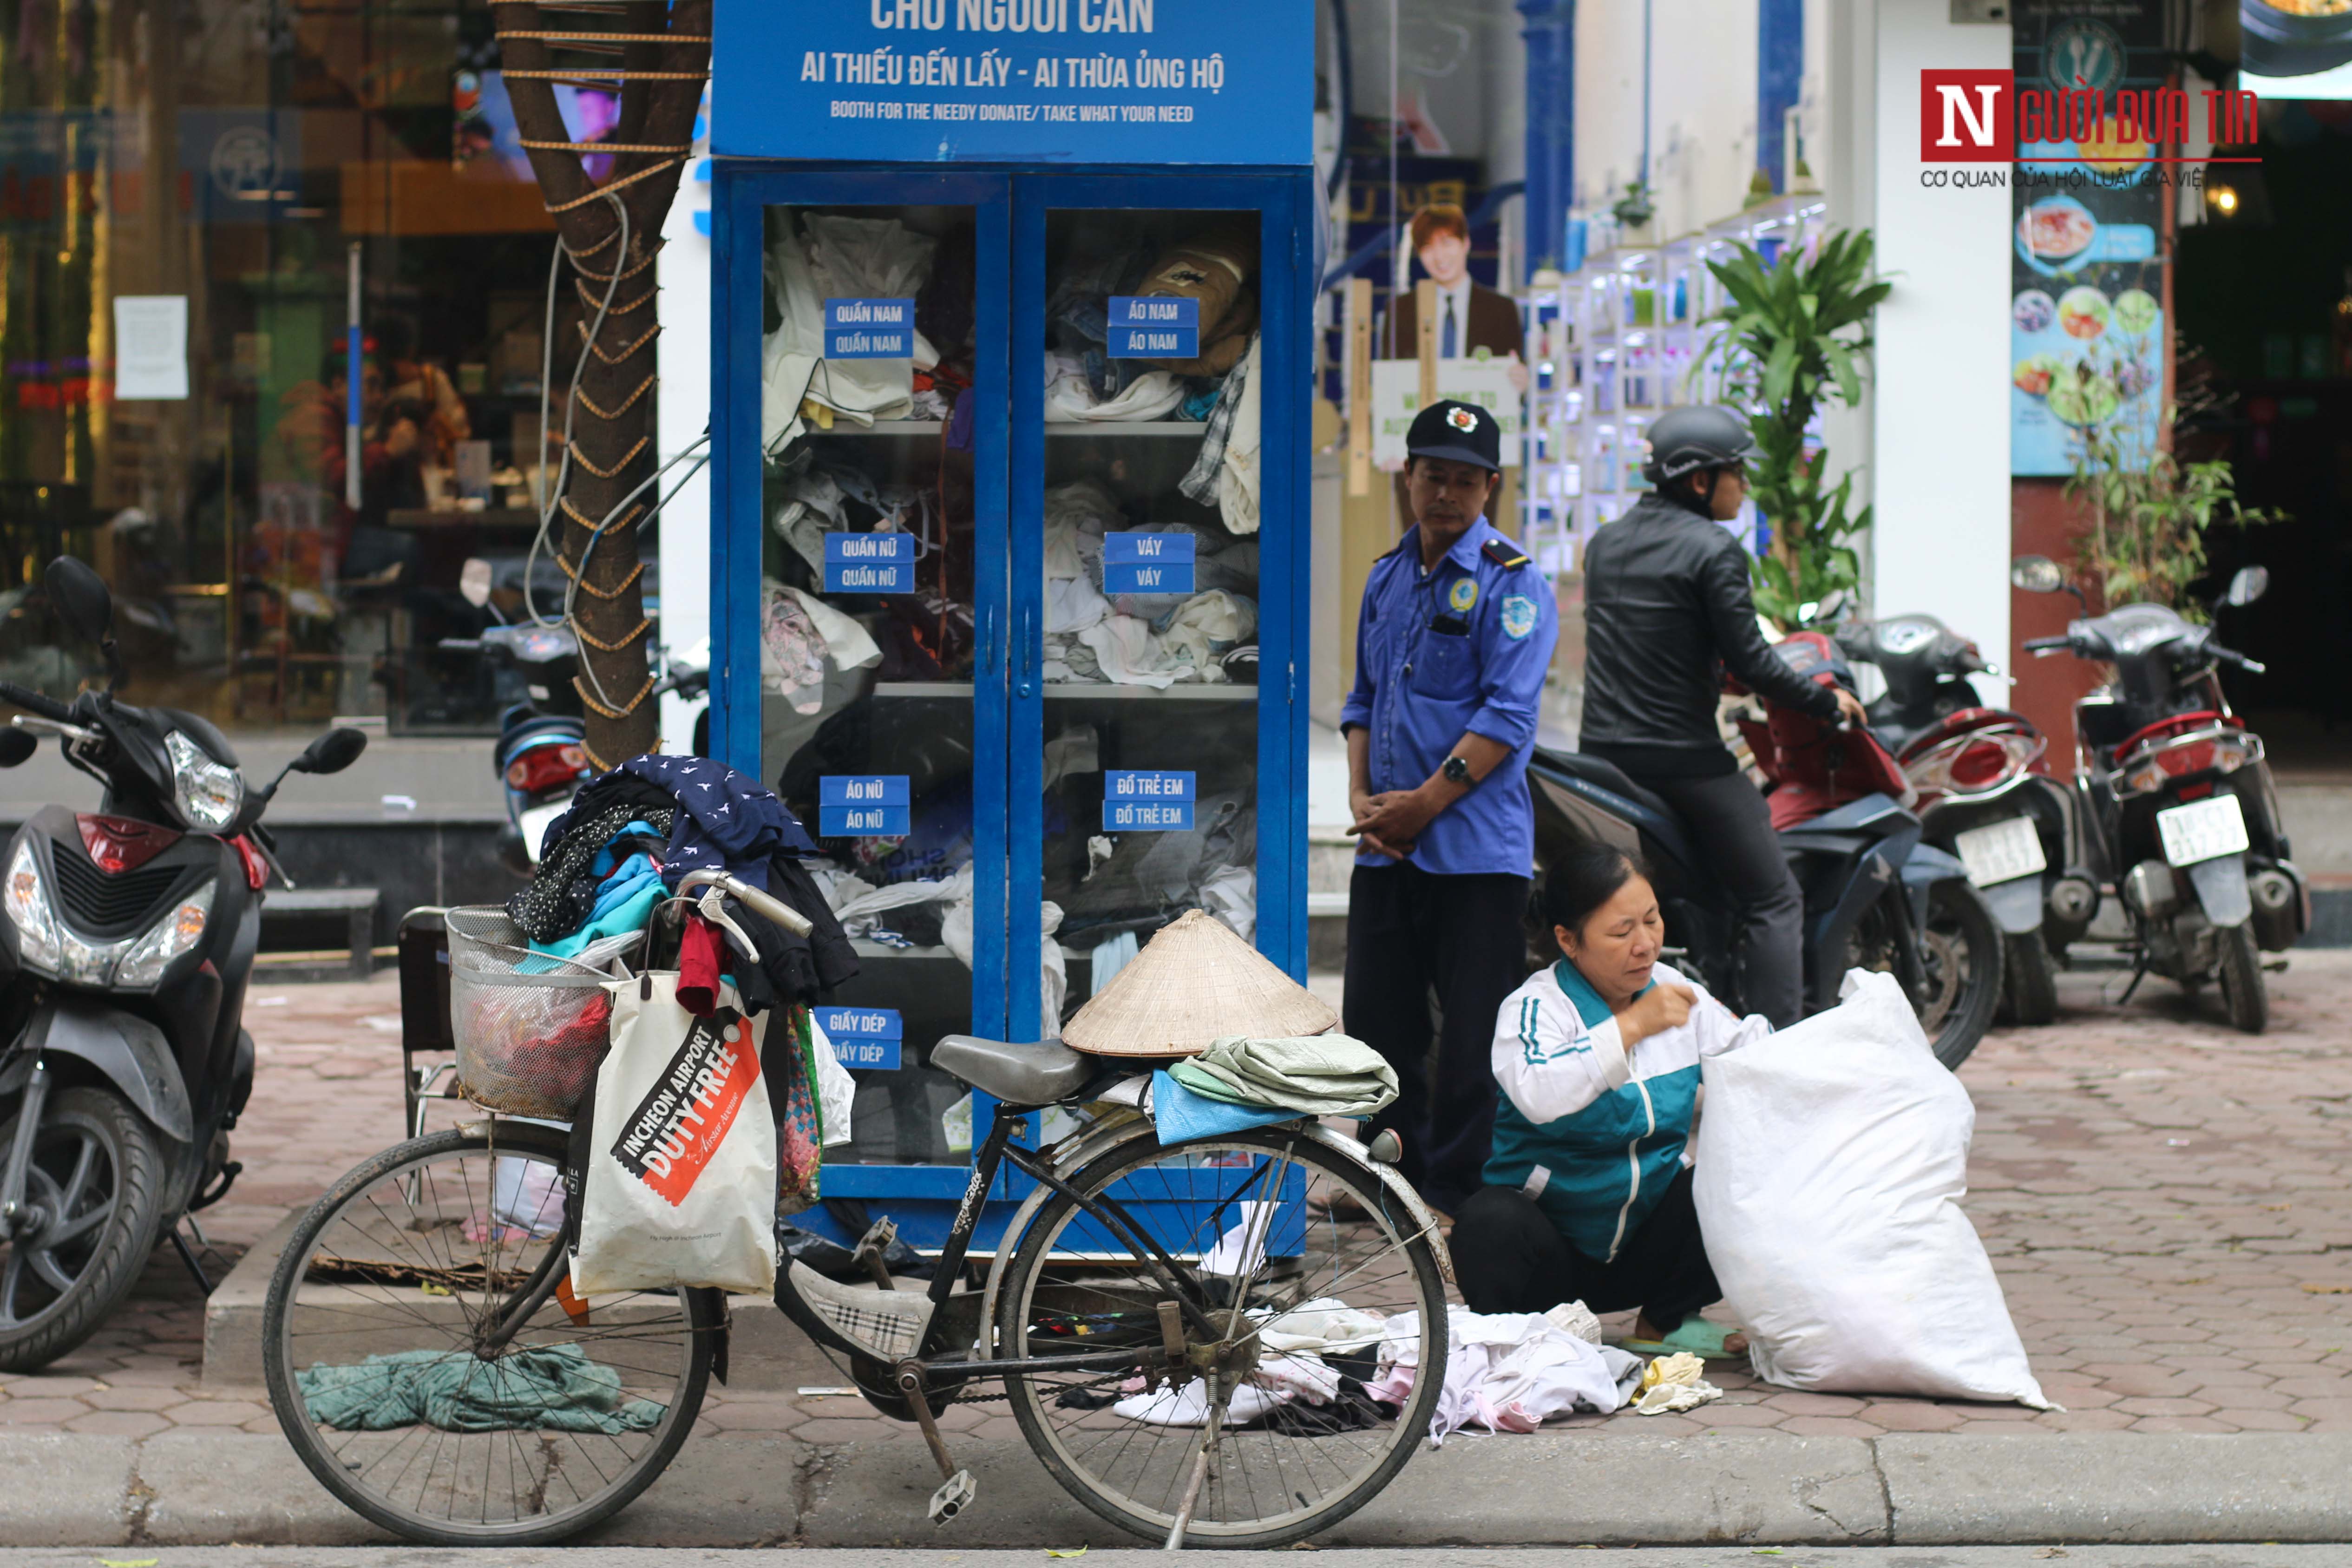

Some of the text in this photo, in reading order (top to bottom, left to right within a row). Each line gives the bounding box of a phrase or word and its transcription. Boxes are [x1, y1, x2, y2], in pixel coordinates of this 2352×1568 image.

[800, 51, 825, 81] AI
[832, 46, 903, 85] THIẾU
[908, 47, 957, 86] ĐẾN
[964, 48, 1011, 86] LẤY
[1034, 58, 1058, 87] AI
[1065, 52, 1129, 88] THỪA
[1136, 49, 1185, 88] ỦNG
[1191, 52, 1224, 94] HỘ
[831, 100, 874, 118] BOOTH
[877, 102, 903, 119] FOR
[905, 103, 931, 120] THE
[933, 104, 977, 121] NEEDY
[1042, 105, 1077, 121] TAKE
[1080, 105, 1118, 122] WHAT
[1120, 106, 1156, 122] YOUR
[1159, 106, 1193, 122] NEED
[874, 306, 902, 322] NAM
[1128, 300, 1178, 320] ÁO NAM
[873, 335, 901, 352] NAM
[1127, 330, 1177, 350] ÁO NAM
[879, 537, 897, 557] NỮ
[1137, 537, 1162, 556] VÁY
[879, 567, 897, 586] NỮ
[1136, 567, 1162, 586] VÁY
[846, 779, 884, 799] ÁO NỮ
[1137, 774, 1161, 794] TRẺ
[1164, 779, 1183, 795] EM
[846, 809, 884, 828] ÁO NỮ
[1136, 803, 1160, 824] TRẺ
[1162, 808, 1181, 824] EM
[861, 1013, 886, 1033] DÉP
[860, 1043, 884, 1062] DÉP
[622, 1026, 712, 1157] INCHEON AIRPORT
[640, 1040, 738, 1179] DUTY FREE
[695, 1092, 739, 1165] Airstar Avenue
